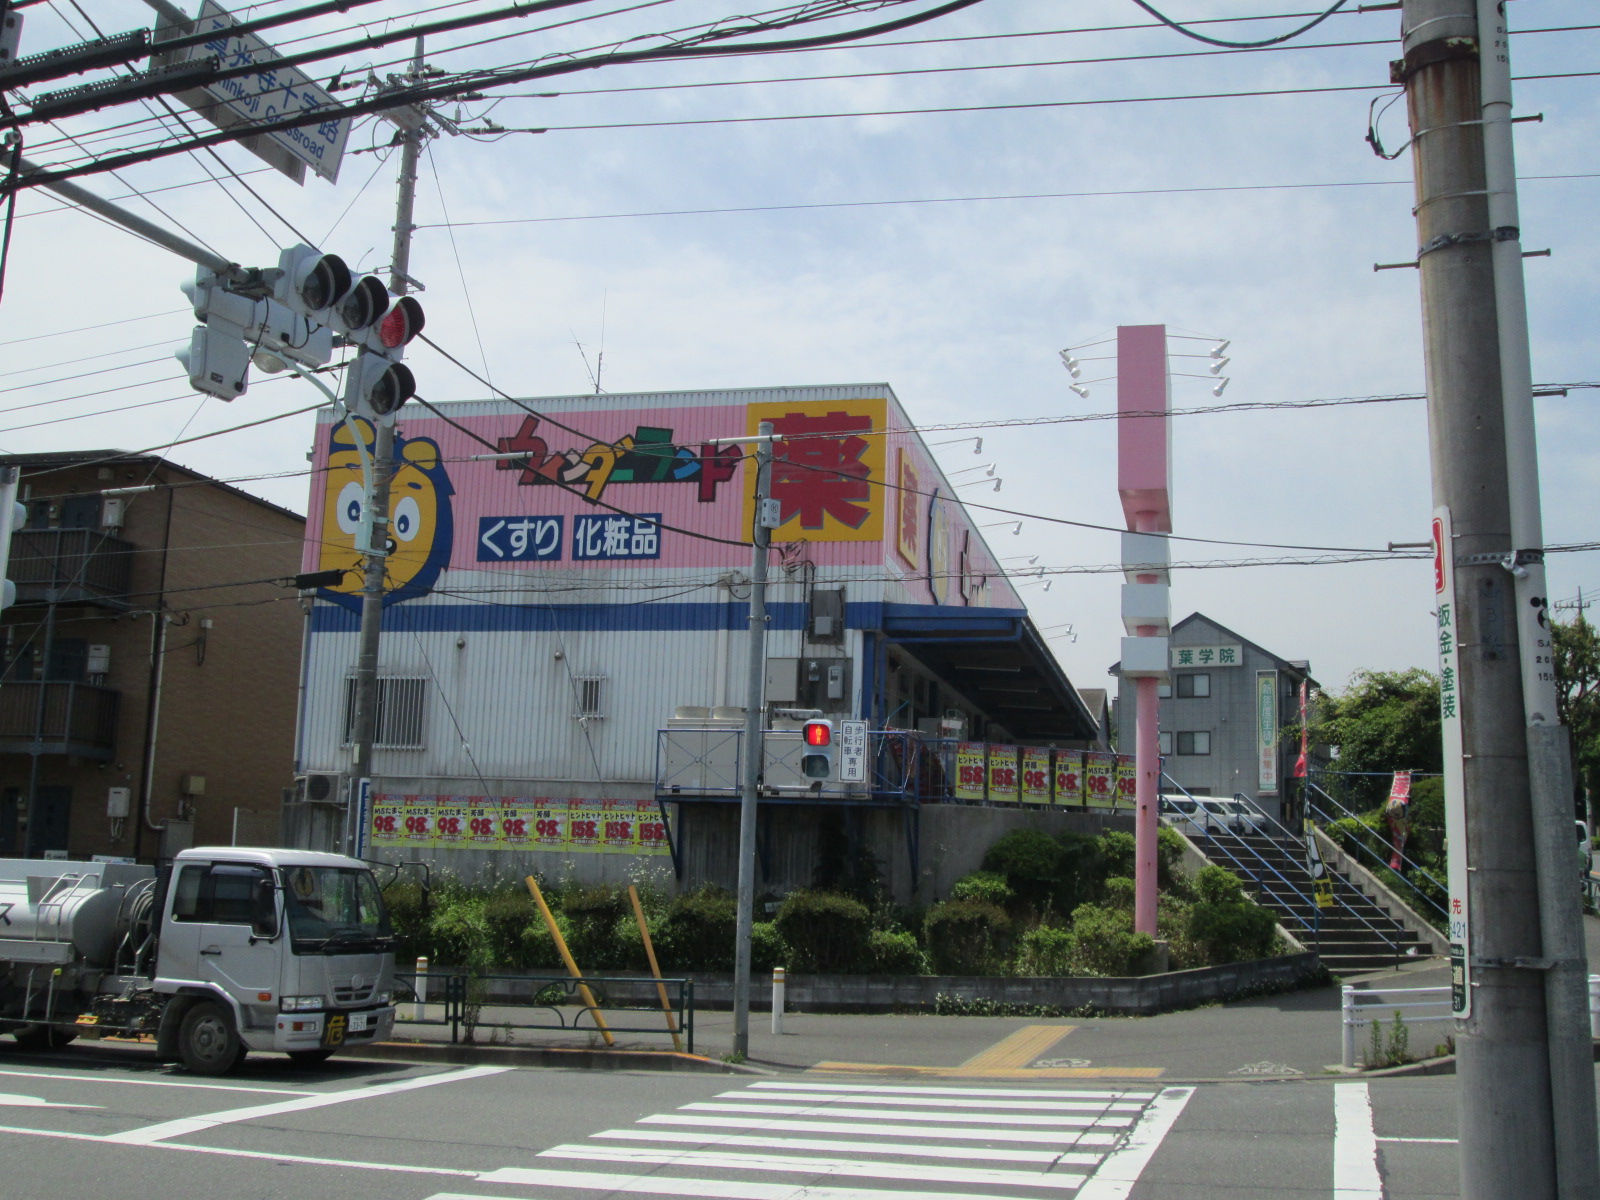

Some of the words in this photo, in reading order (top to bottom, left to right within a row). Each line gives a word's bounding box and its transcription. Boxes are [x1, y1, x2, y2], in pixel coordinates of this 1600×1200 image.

[758, 410, 873, 530] 薬
[481, 518, 560, 558] くすり
[576, 516, 658, 557] 化粧品
[844, 725, 853, 756] 自転車
[854, 726, 864, 756] 歩行者
[847, 757, 857, 778] 専用
[325, 1015, 346, 1046] 危
